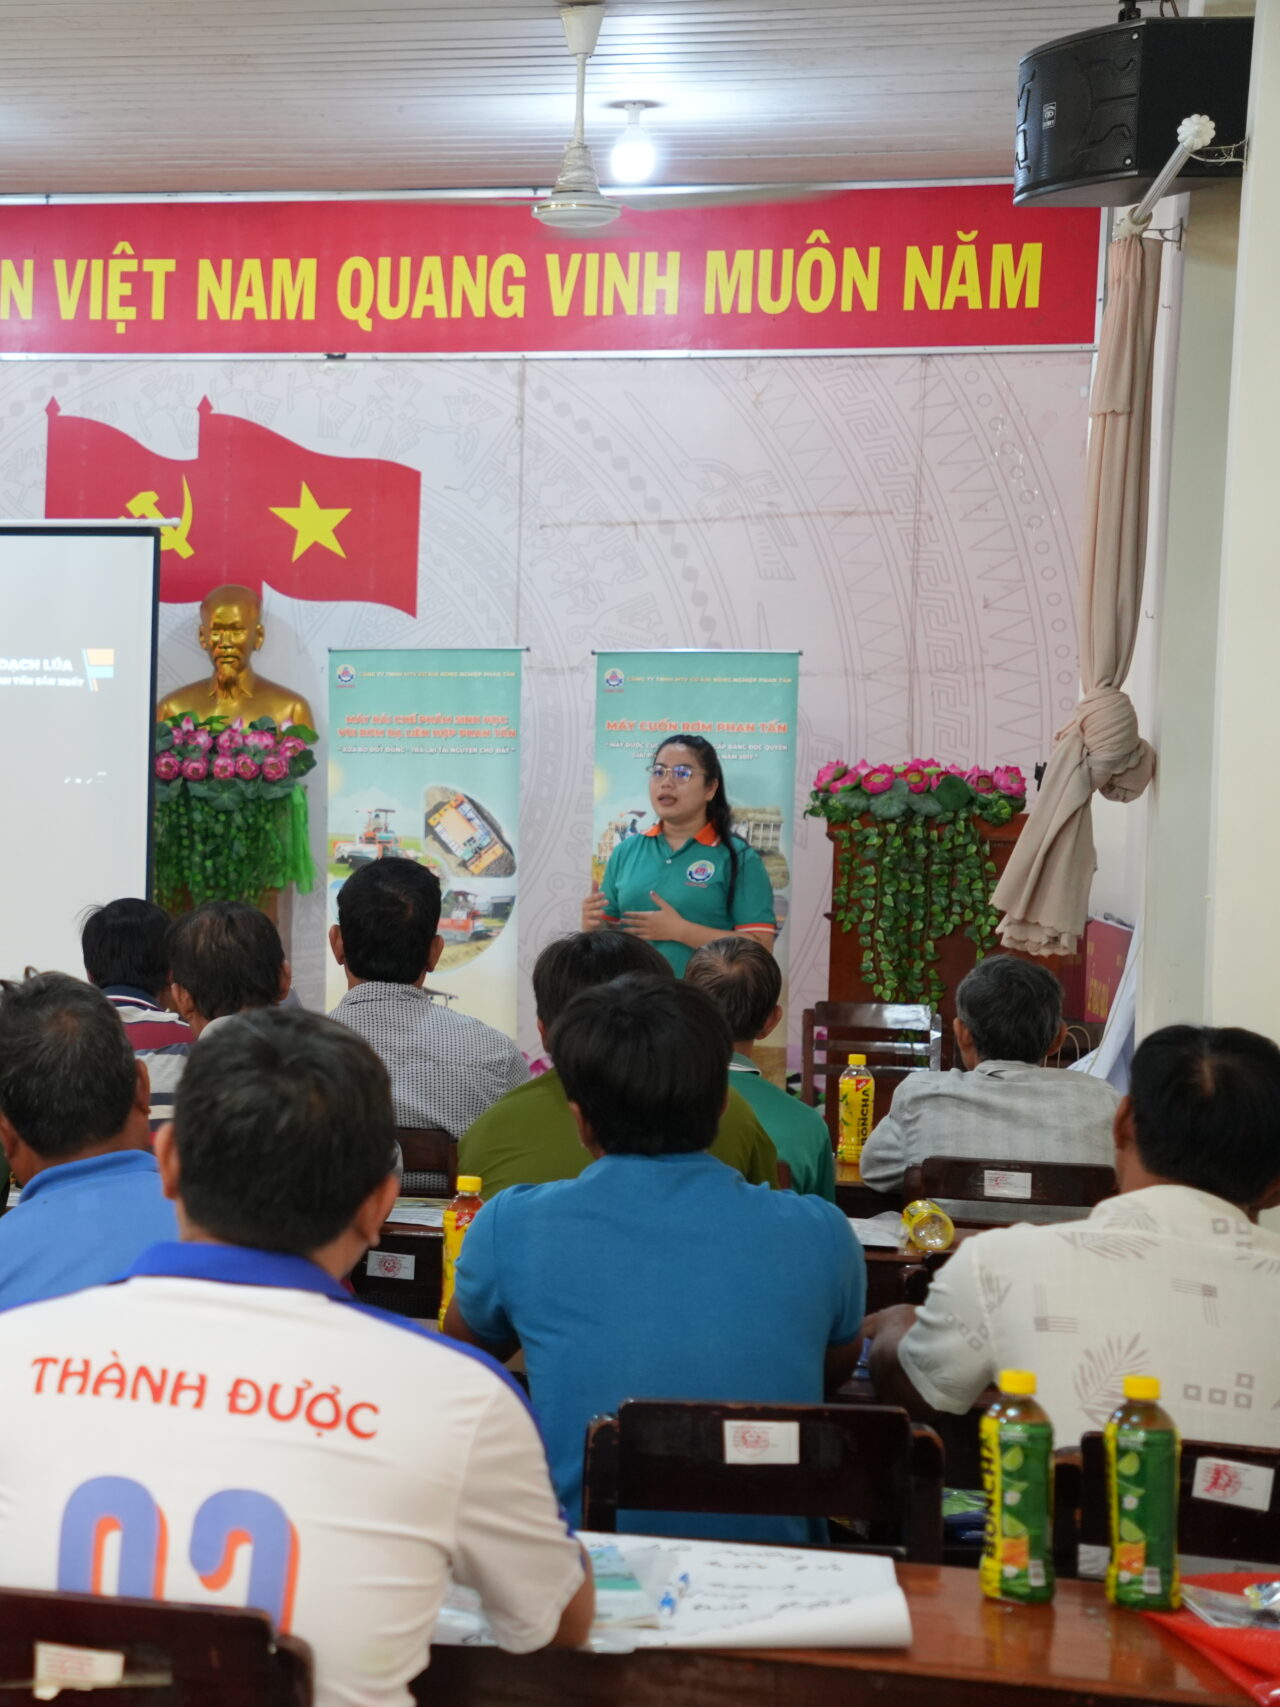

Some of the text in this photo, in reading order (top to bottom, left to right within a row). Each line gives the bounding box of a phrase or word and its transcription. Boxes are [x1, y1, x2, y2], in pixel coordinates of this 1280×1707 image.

[54, 242, 176, 334] VIỆT
[197, 257, 317, 321] NAM
[337, 253, 526, 332] QUANG
[546, 252, 679, 316] VINH
[705, 229, 881, 314] MUÔN
[903, 230, 1043, 311] NĂM
[606, 717, 788, 734] MÁY CUỐN RƠM PHAN TẤN
[32, 1351, 380, 1440] THÀNH ĐƯỢC
